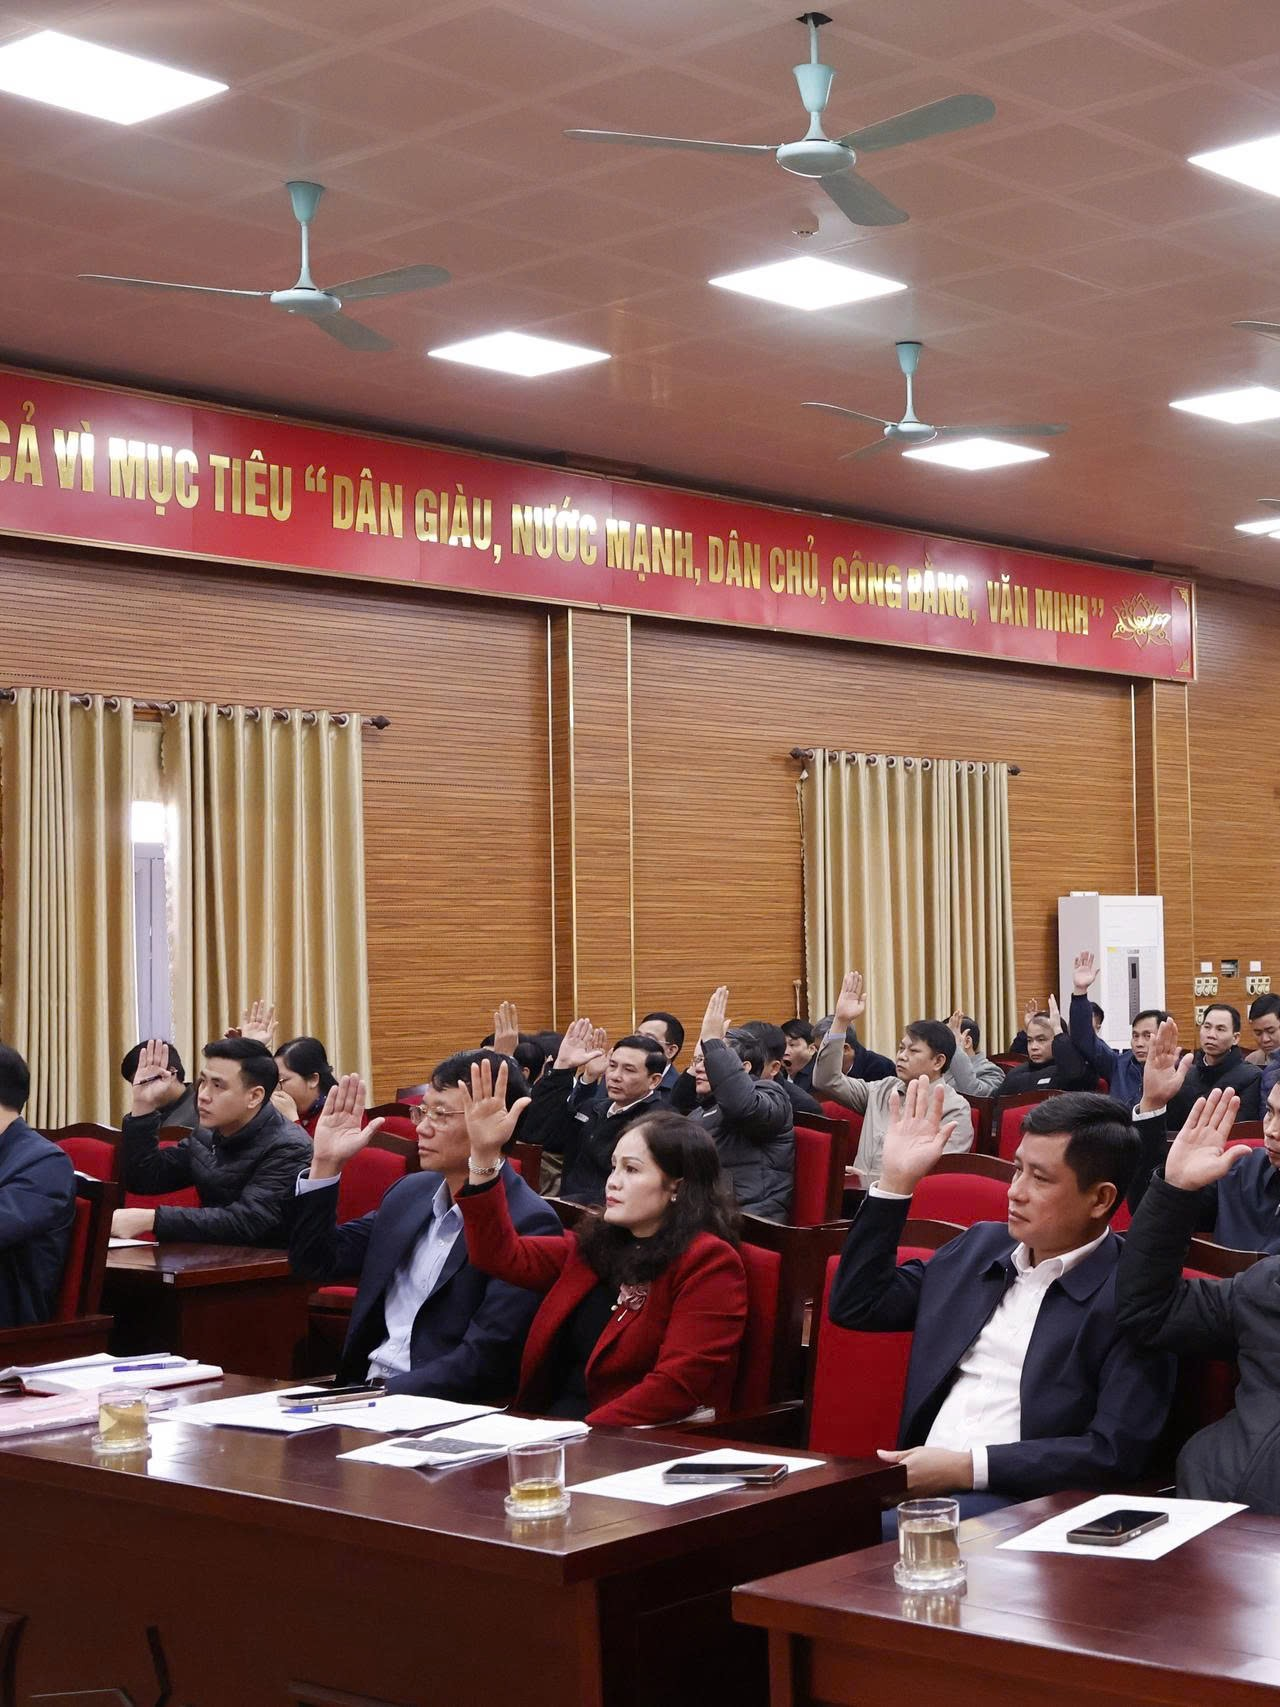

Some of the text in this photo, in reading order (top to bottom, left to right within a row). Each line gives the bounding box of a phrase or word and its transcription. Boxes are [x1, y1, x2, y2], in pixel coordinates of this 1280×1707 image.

[53, 420, 95, 492] VÌ
[108, 437, 200, 515] MỤC
[209, 449, 292, 522] TIÊU
[415, 483, 501, 564] GIÀU,
[511, 495, 597, 566] NƯỚC
[605, 518, 700, 586] MẠNH,
[708, 529, 761, 590] DÂN
[769, 534, 827, 605] CHỦ,
[832, 550, 902, 609] CÔNG
[907, 552, 977, 626] BẰNG,
[986, 573, 1028, 628] VĂN
